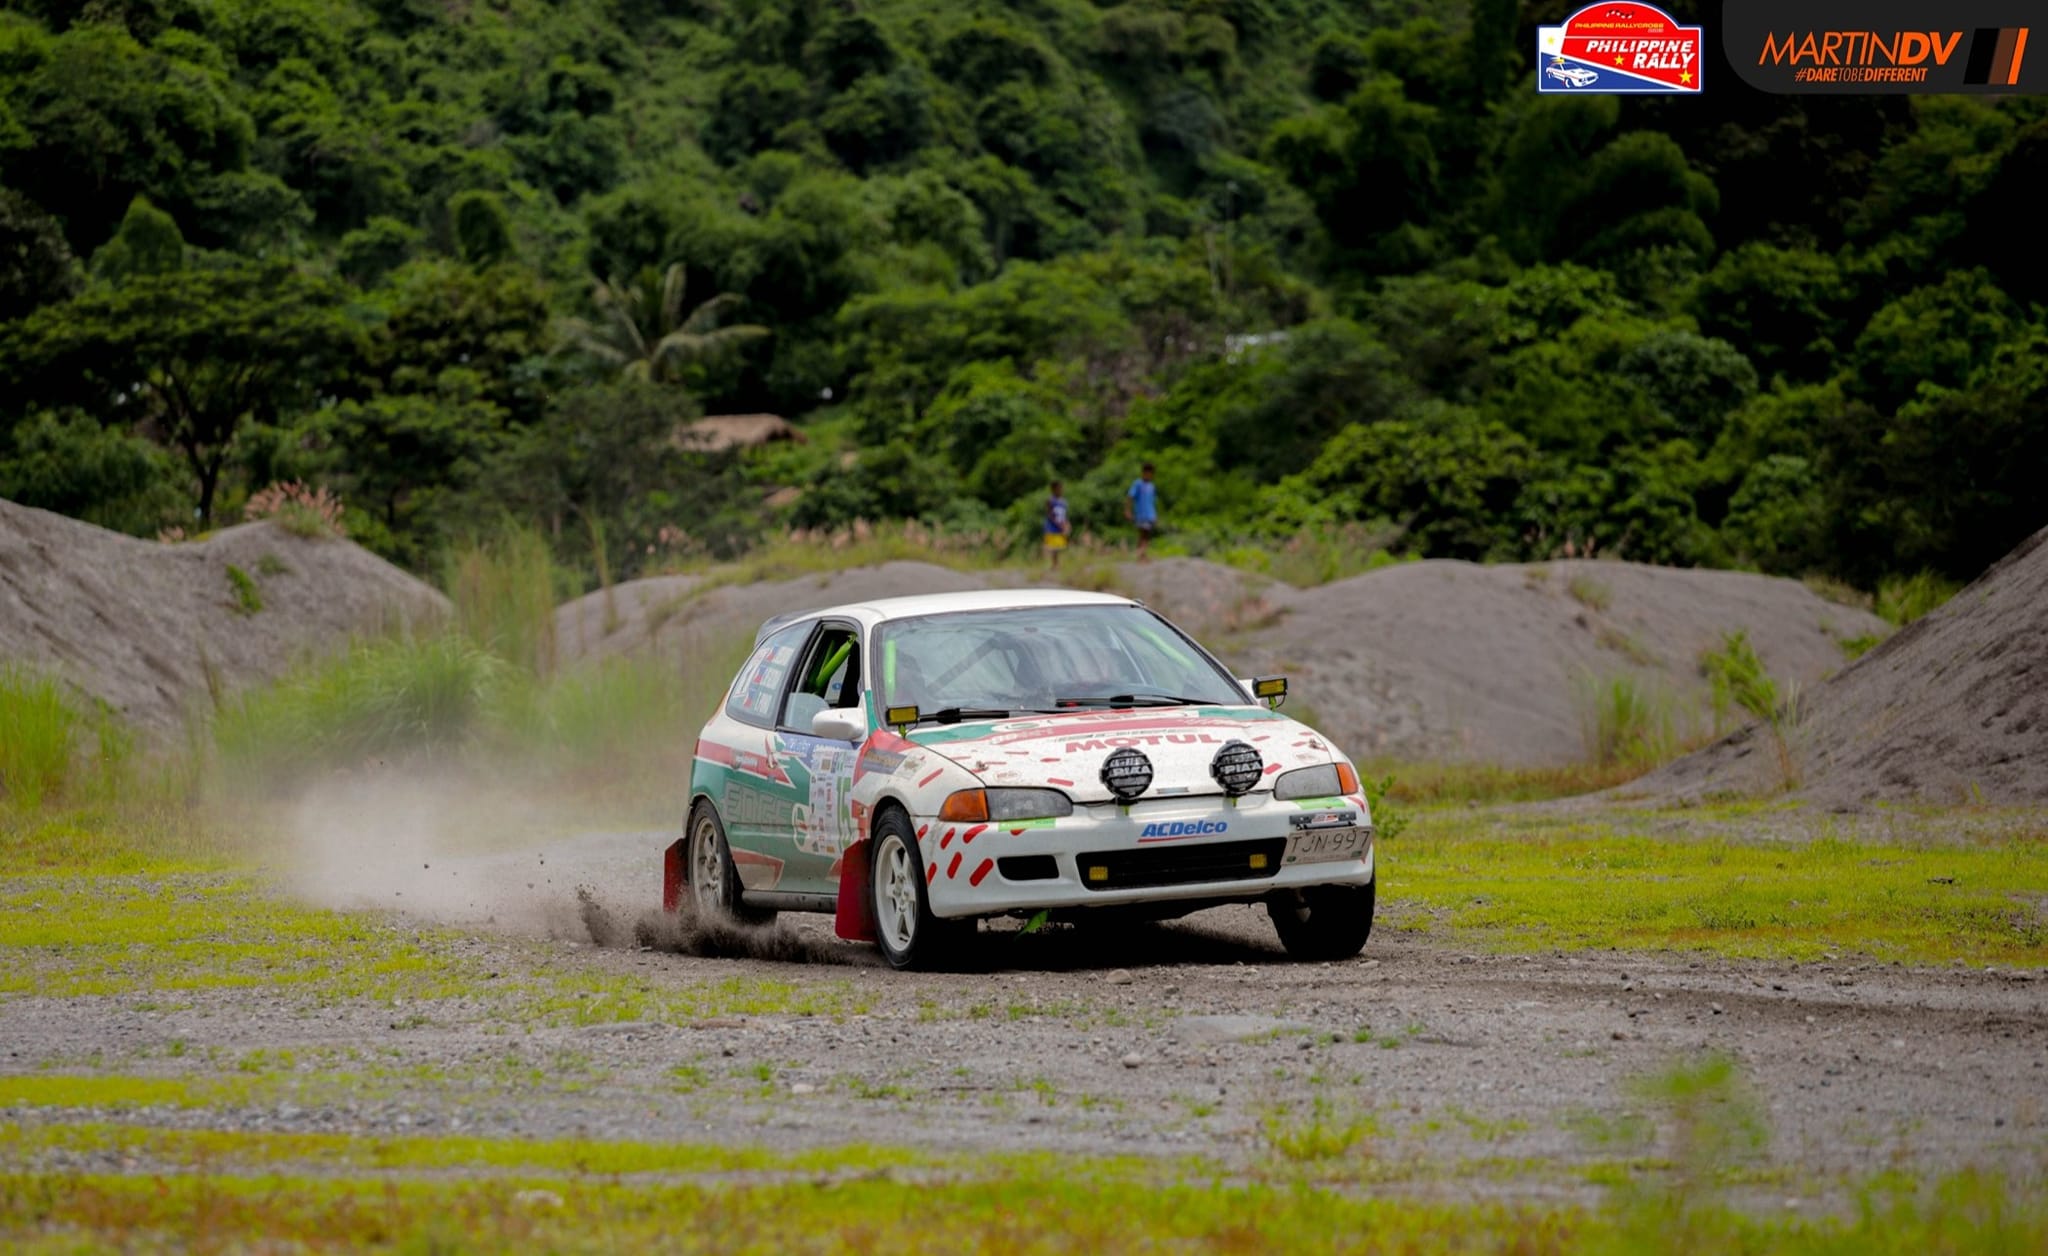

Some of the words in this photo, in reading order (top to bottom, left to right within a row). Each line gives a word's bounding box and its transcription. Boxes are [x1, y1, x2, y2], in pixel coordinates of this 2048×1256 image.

[1065, 733, 1223, 753] MOTUL
[1223, 761, 1262, 775] PIAA
[1141, 820, 1228, 838] ACDelco
